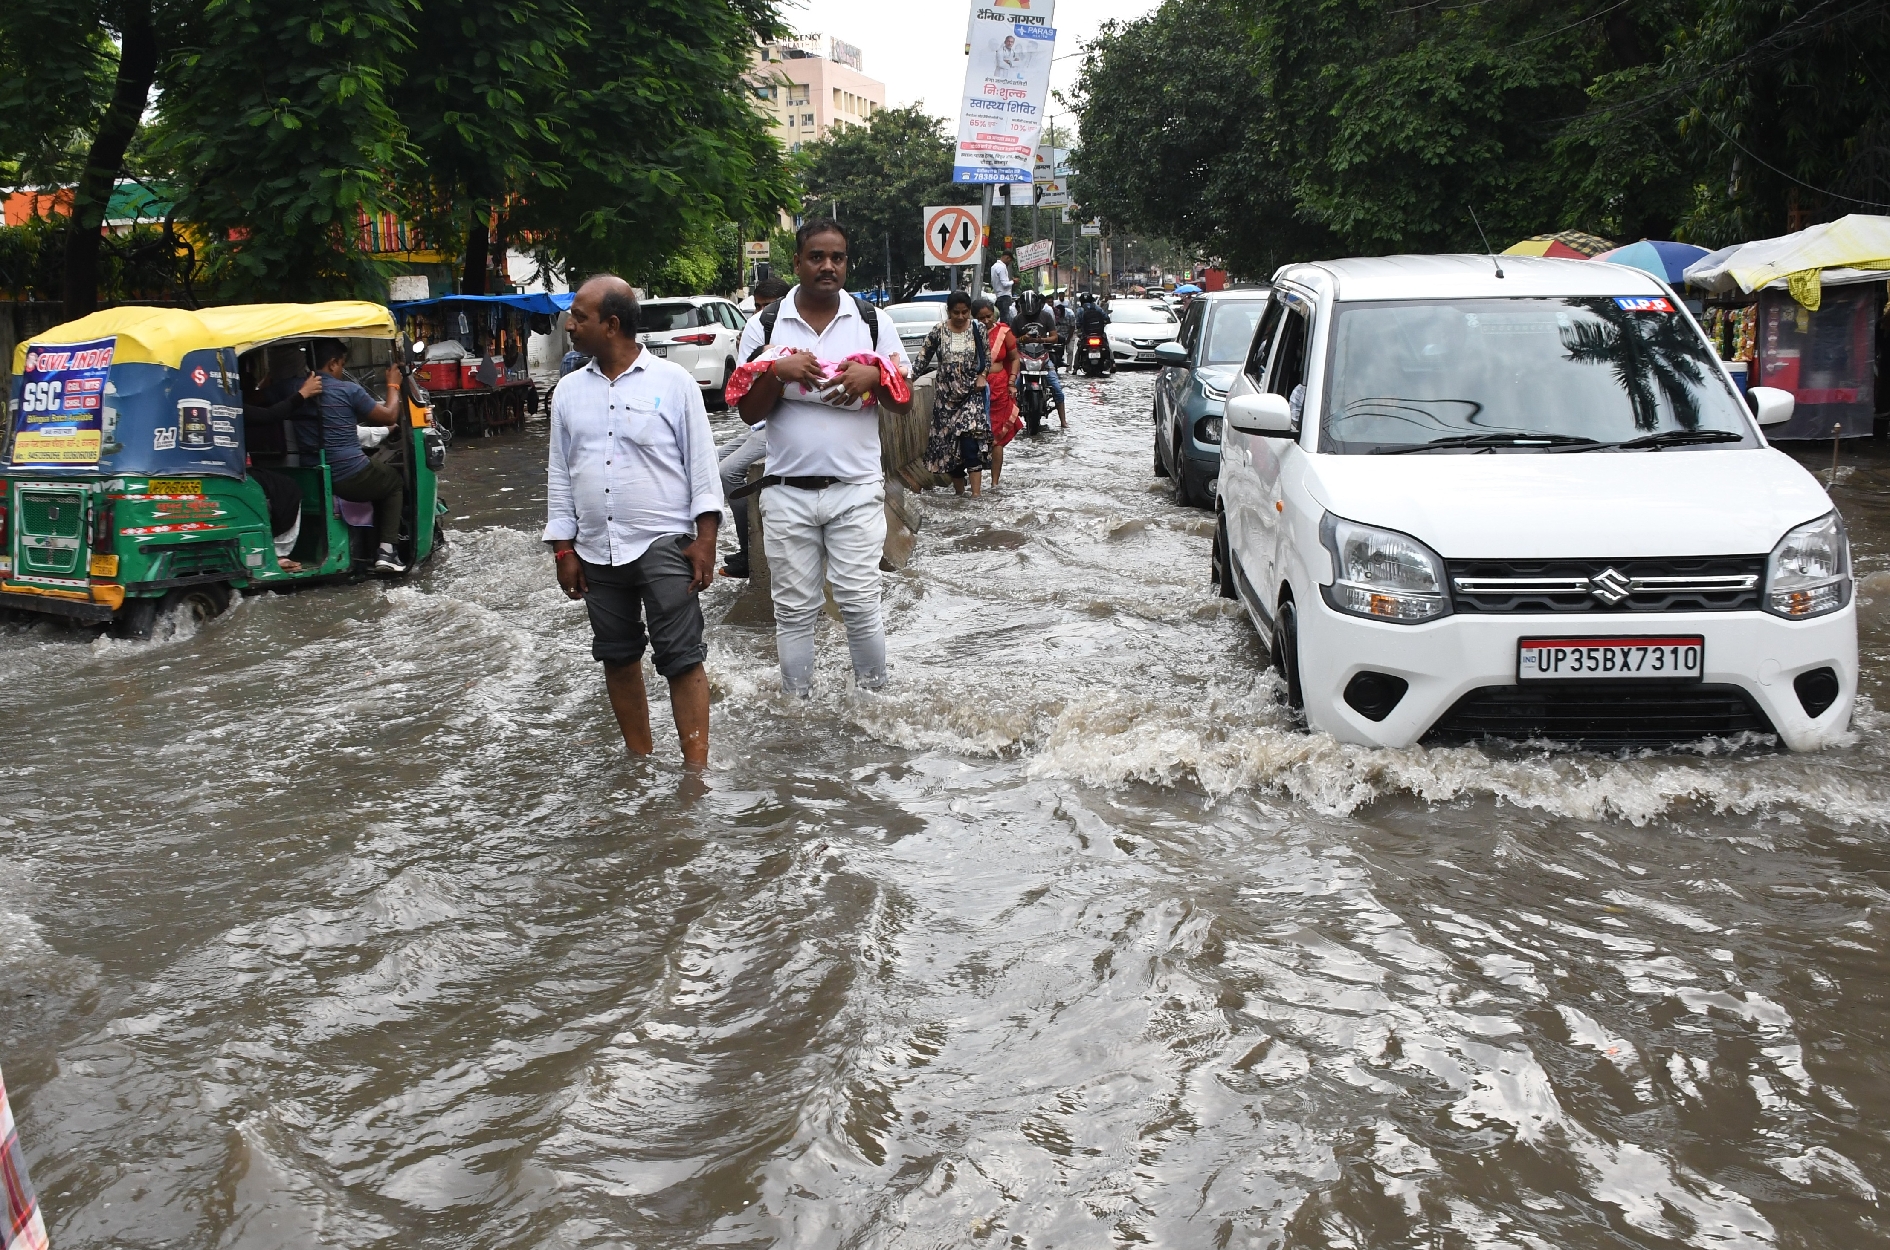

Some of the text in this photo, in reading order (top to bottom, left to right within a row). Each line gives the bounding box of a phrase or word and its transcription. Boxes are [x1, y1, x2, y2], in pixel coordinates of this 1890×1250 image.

[977, 9, 1045, 25] दैनिक जागरण
[1027, 26, 1054, 36] PARAS
[970, 98, 1037, 115] स्वास्थ्य शिविर
[969, 119, 987, 128] 65%
[1011, 124, 1026, 133] 10%
[37, 347, 114, 373] CIVIL INDIA
[23, 381, 62, 411] SSC
[1523, 647, 1697, 673] IND UP35BX7310
